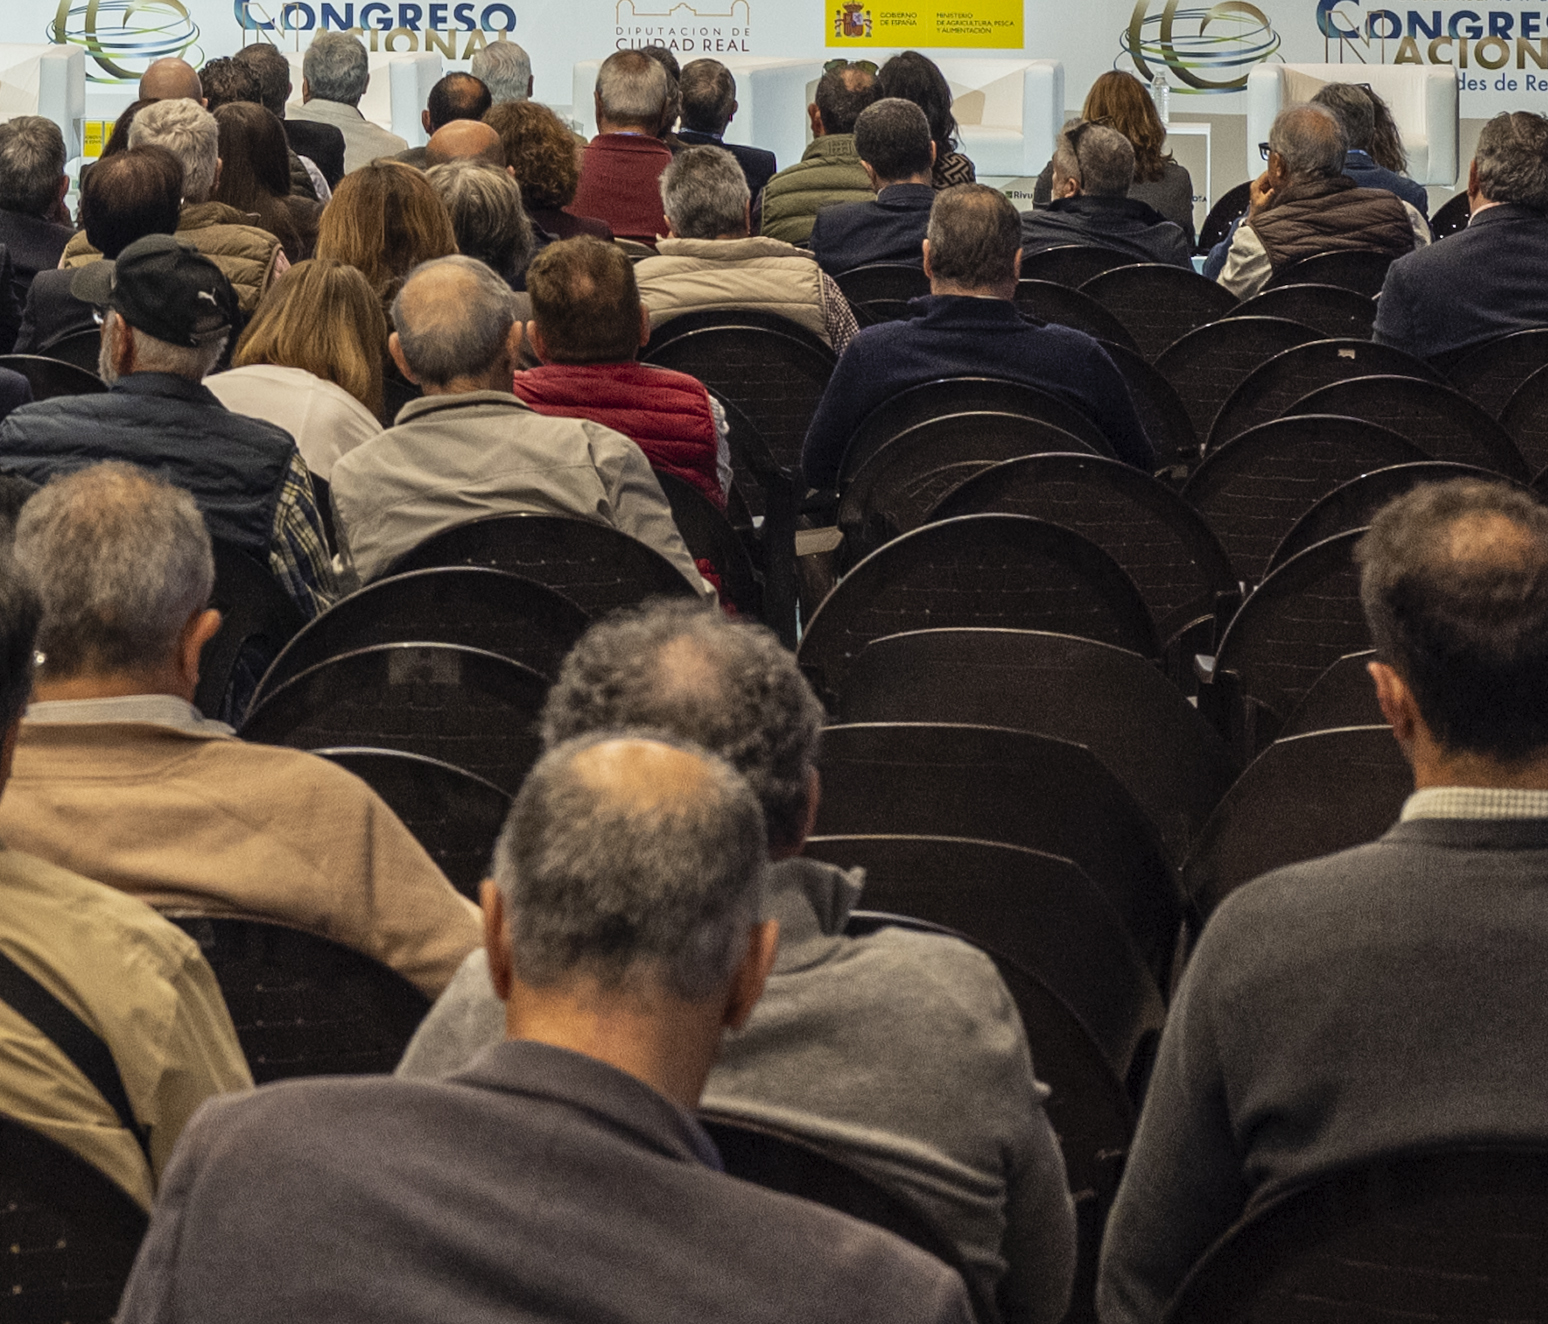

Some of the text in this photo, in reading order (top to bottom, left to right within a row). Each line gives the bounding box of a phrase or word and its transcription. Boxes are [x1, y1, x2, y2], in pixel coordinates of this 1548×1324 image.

[880, 12, 917, 20] GOBIERNO
[936, 12, 973, 20] MINISTERIO
[892, 19, 917, 27] ESPAÑA
[994, 20, 1015, 28] PESCA
[615, 26, 749, 37] DIPUTACIÓN DE
[615, 38, 750, 53] CIUDAD REAL
[1493, 72, 1517, 93] de
